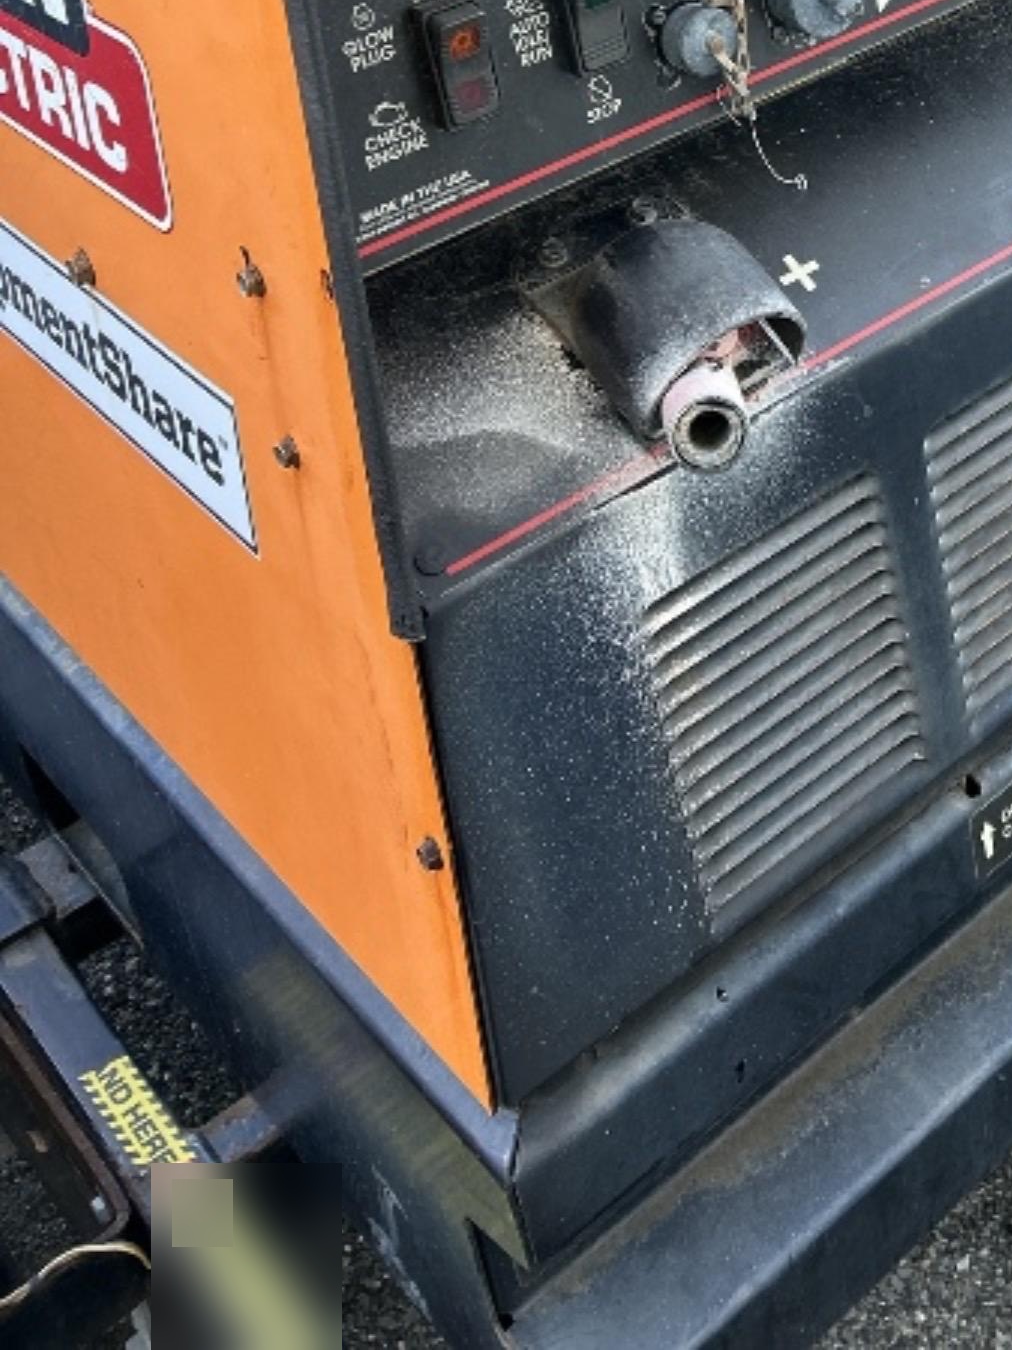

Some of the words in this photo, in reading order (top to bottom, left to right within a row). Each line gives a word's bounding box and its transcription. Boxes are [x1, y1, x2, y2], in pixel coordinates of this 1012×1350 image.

[342, 25, 394, 57] GLOW
[350, 44, 397, 73] PLUG
[364, 117, 427, 152] CHECK
[364, 135, 429, 172] ENGINE
